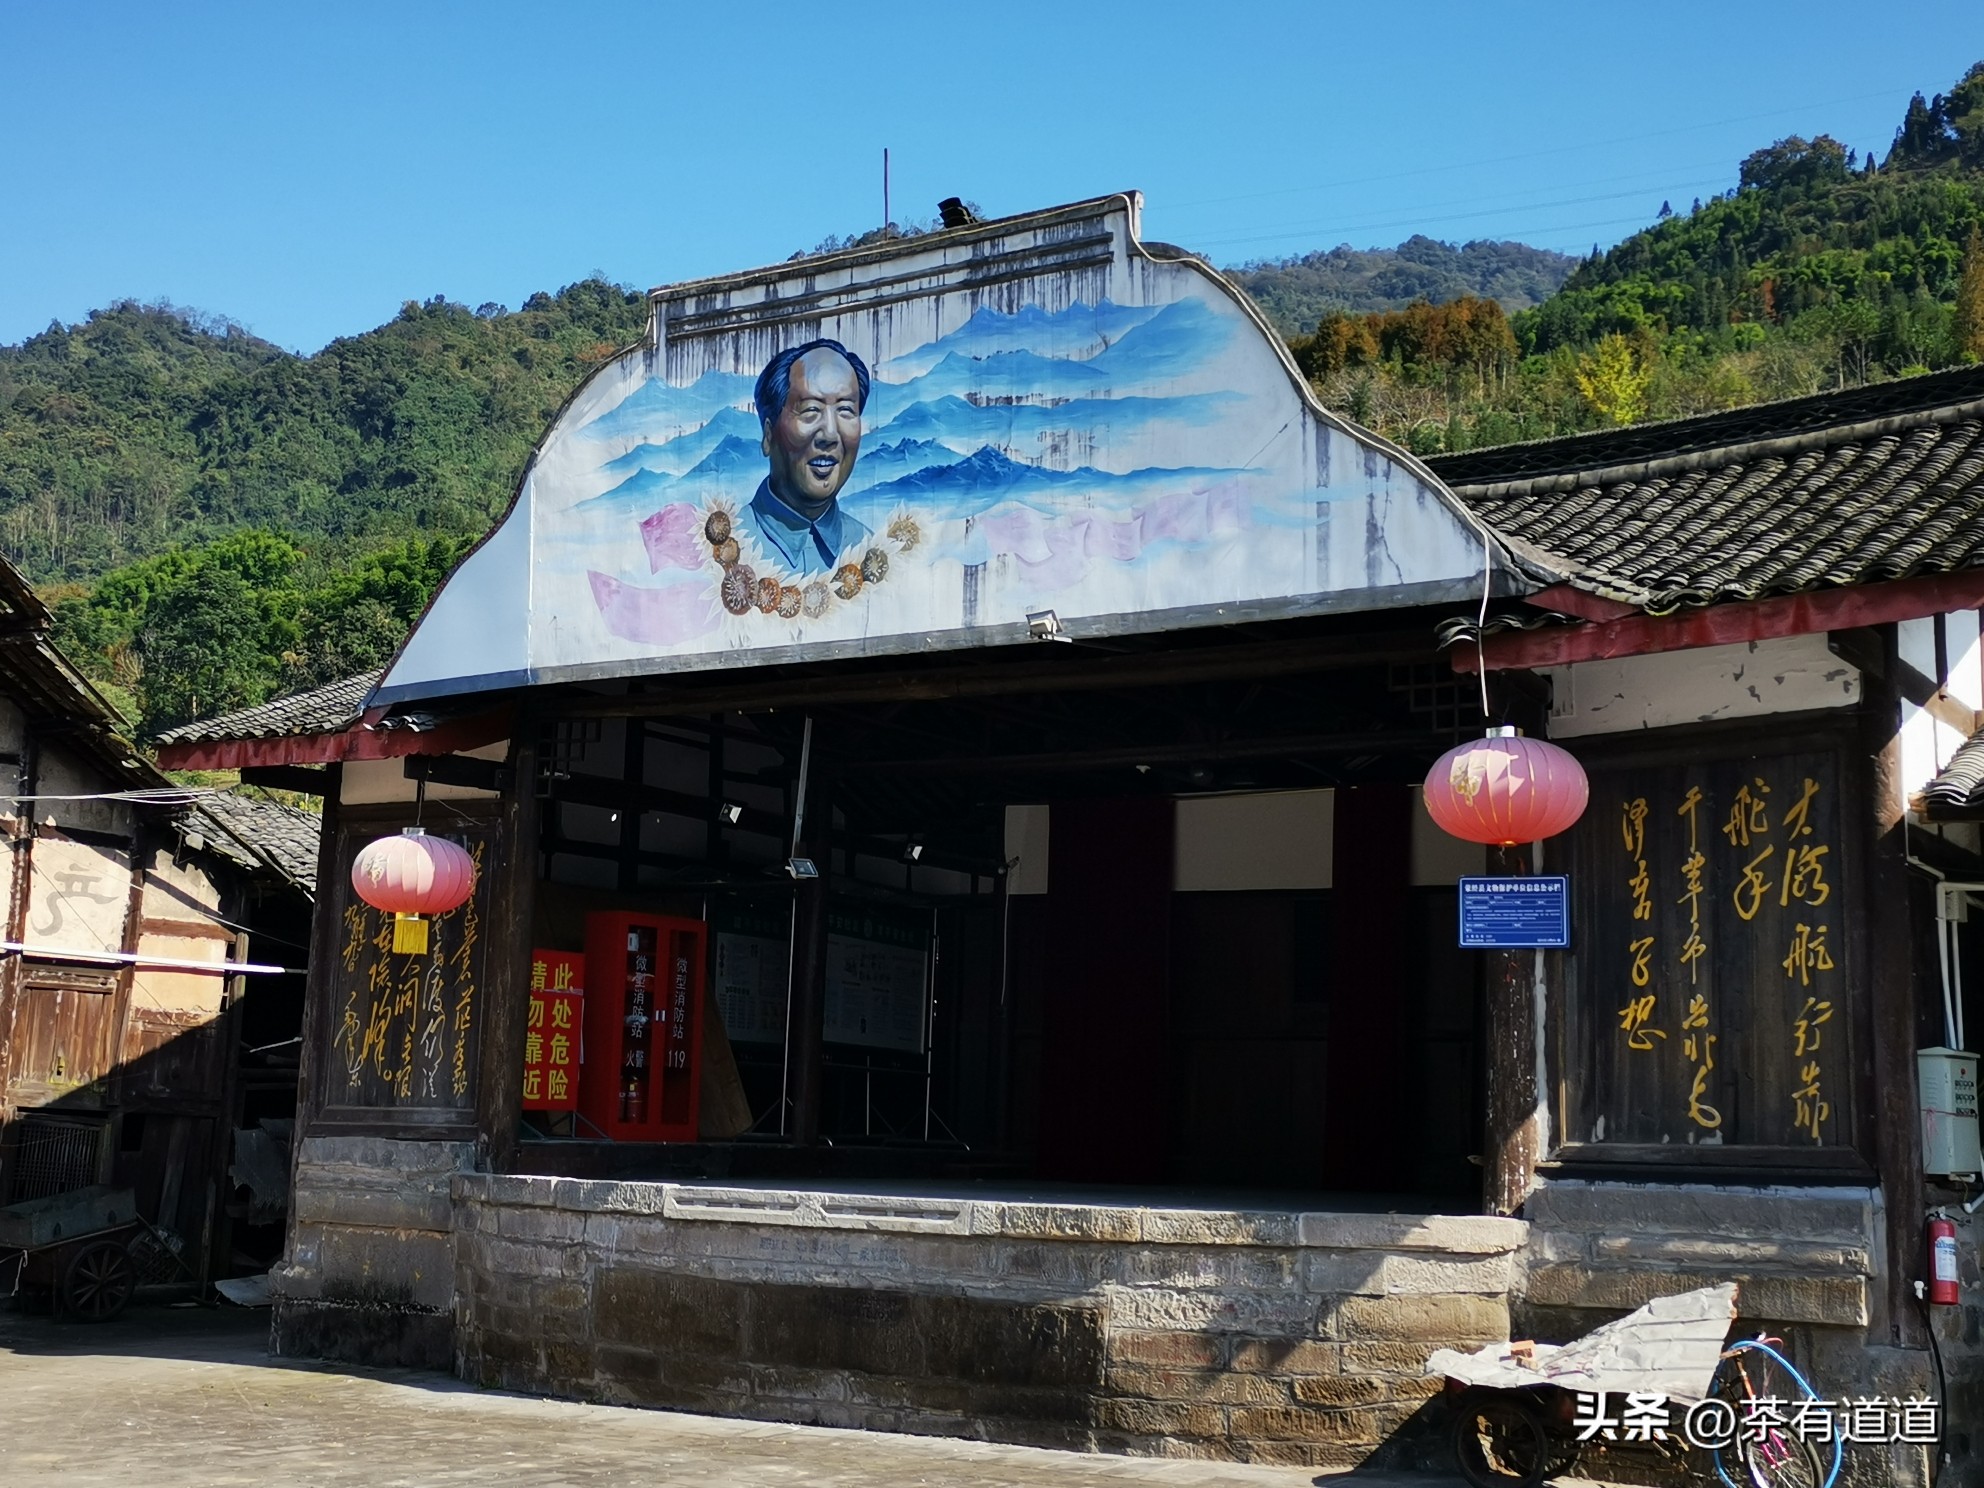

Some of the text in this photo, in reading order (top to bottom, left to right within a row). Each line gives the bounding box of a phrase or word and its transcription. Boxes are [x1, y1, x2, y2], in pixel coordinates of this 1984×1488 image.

[523, 960, 547, 1099] 请勿靠近
[549, 963, 574, 1100] 此处危险
[630, 953, 650, 1039] 微型消防站
[672, 956, 688, 1040] 微型消防站
[625, 1049, 686, 1069] 火警 119
